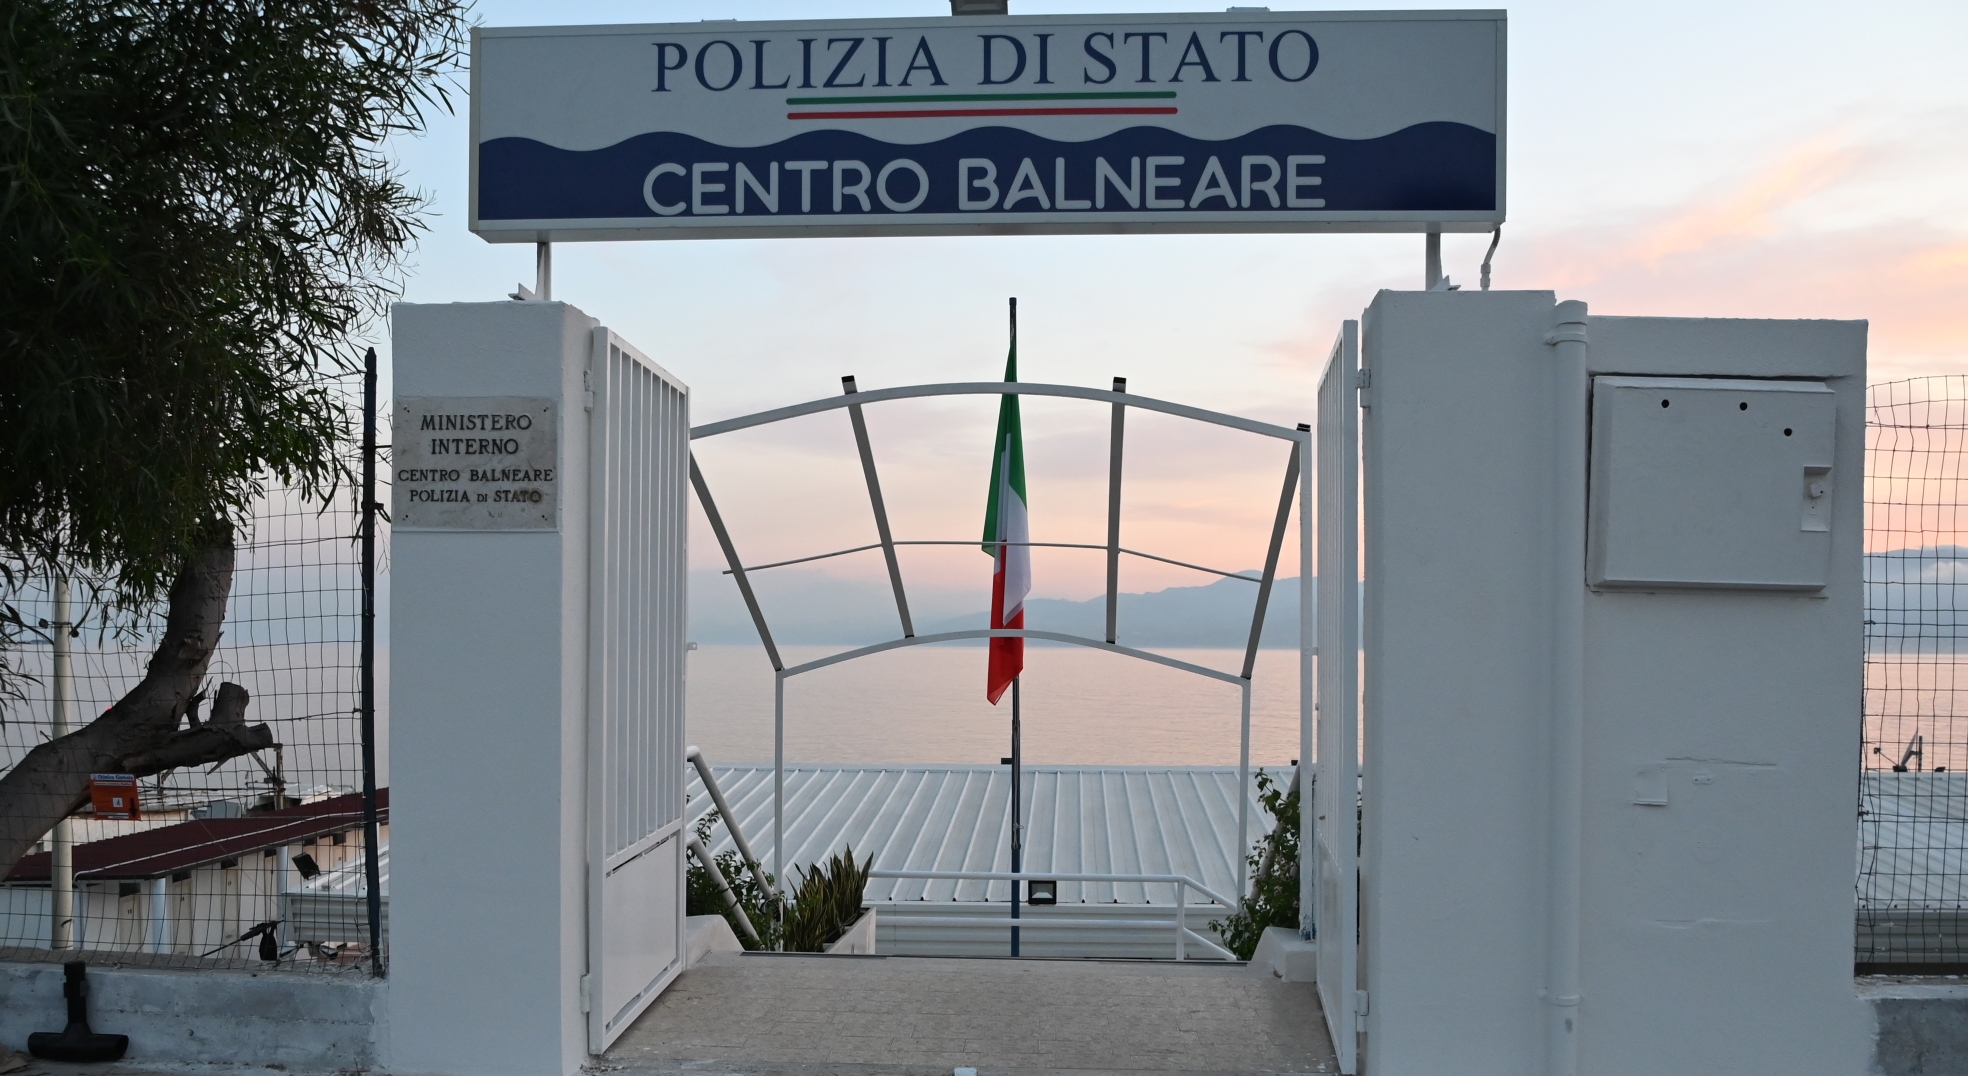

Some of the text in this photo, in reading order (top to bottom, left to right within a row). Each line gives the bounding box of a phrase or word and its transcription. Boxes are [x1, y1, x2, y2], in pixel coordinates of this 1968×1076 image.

[651, 29, 1319, 92] POLIZIA DI STATO
[643, 154, 1326, 216] CENTRO BALNEARE
[420, 414, 532, 431] MINISTERO
[431, 438, 519, 455] INTERNO
[398, 469, 553, 482] CENTRO BALNEARE
[410, 489, 470, 503] POLIZIA
[493, 489, 542, 503] STATO
